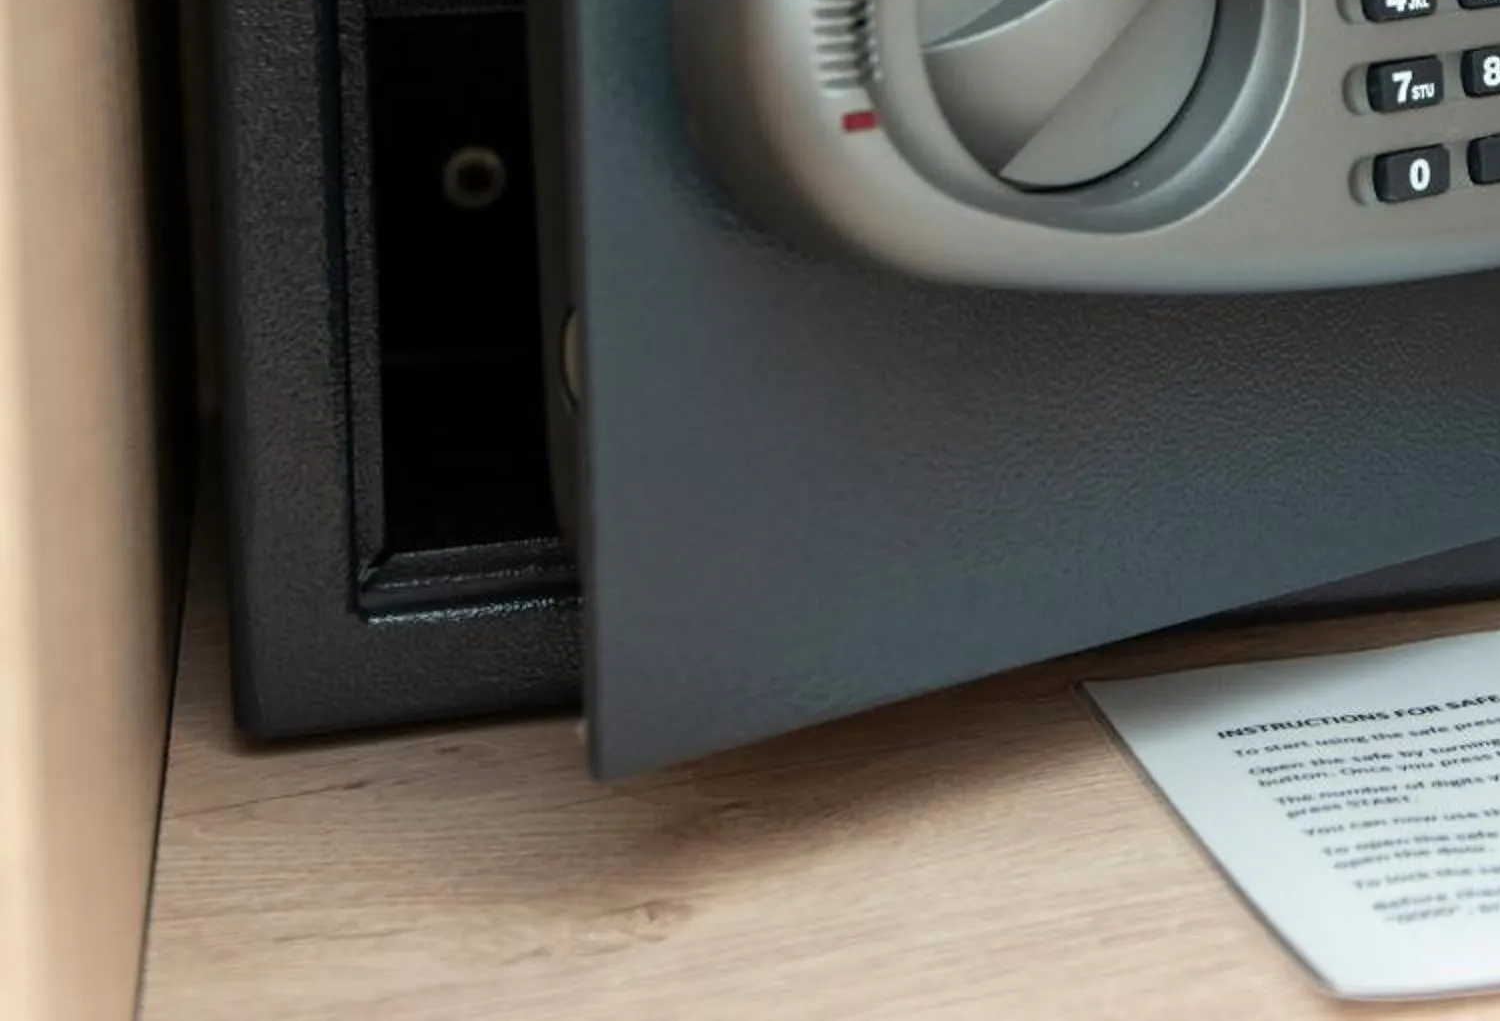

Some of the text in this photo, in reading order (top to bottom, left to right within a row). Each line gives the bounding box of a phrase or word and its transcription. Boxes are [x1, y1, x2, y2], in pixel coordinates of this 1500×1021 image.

[1410, 159, 1430, 191] 0
[1217, 712, 1390, 738] INSTRUCTIONS
[1393, 704, 1443, 718] FOR
